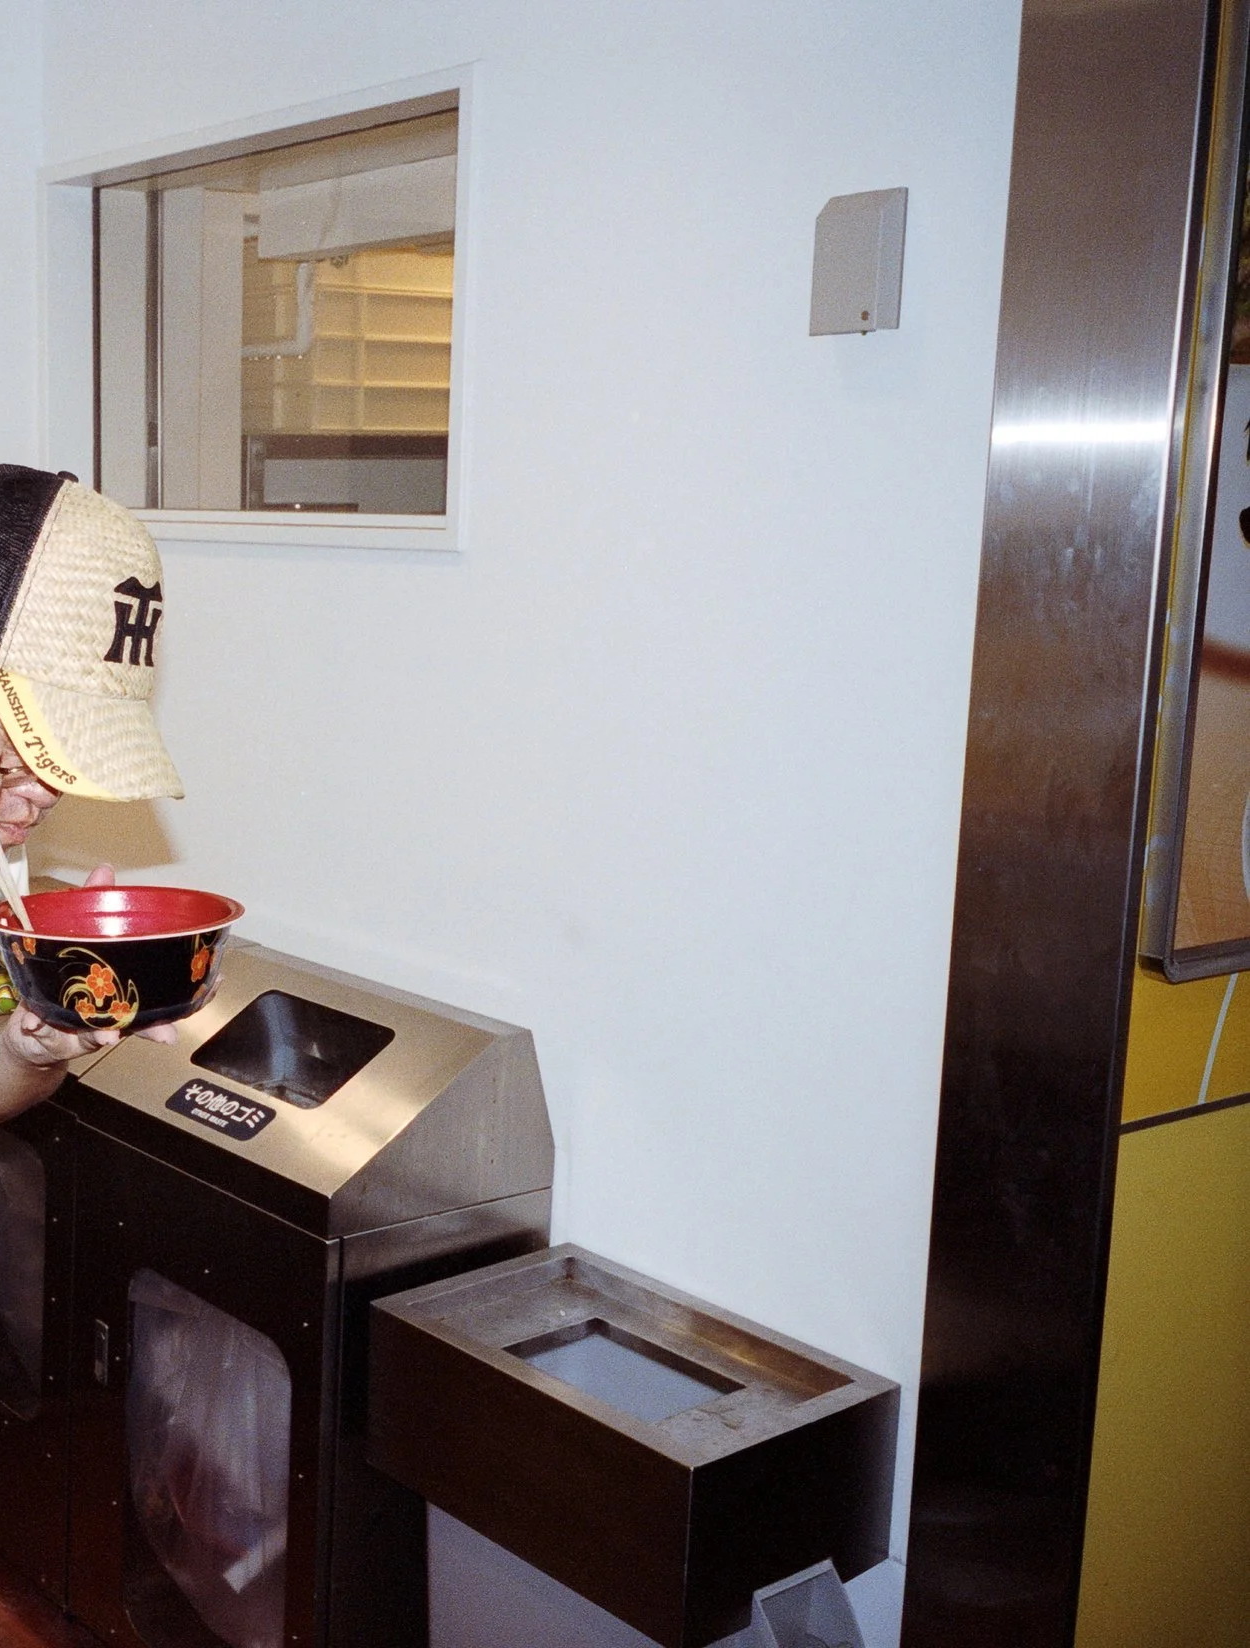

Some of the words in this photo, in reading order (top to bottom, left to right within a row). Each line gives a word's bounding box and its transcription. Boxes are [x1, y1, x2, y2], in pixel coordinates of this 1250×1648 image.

[24, 735, 78, 786] Tigers
[184, 1083, 266, 1128] その他のゴミ
